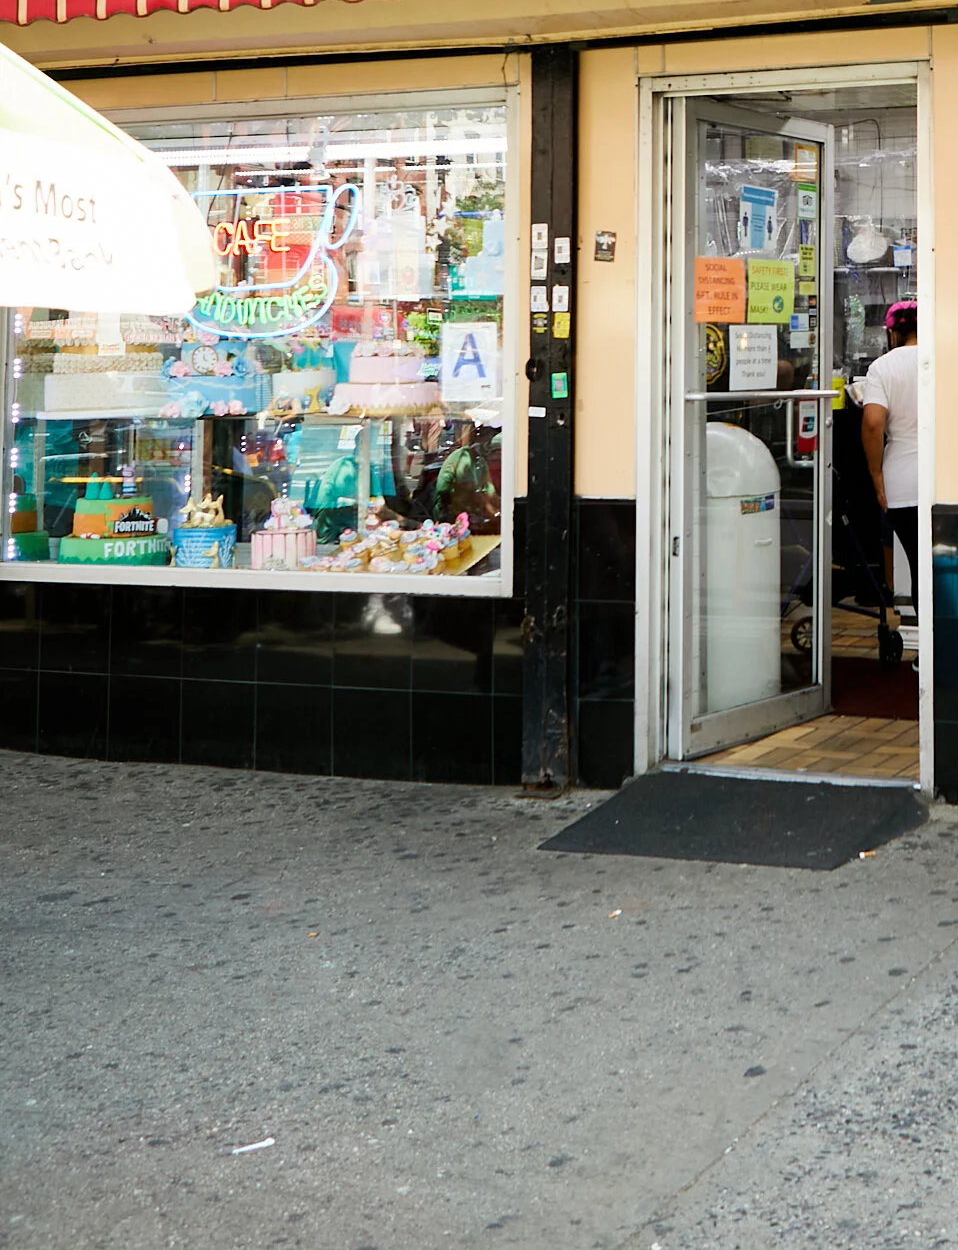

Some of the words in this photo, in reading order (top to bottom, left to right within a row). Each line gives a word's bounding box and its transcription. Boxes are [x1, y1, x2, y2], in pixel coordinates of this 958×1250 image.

[0, 174, 23, 210] 's
[35, 180, 96, 223] Most
[213, 219, 291, 256] CAFE
[196, 275, 328, 325] NDWICHES
[452, 333, 486, 378] A
[114, 520, 154, 533] FORTNITE
